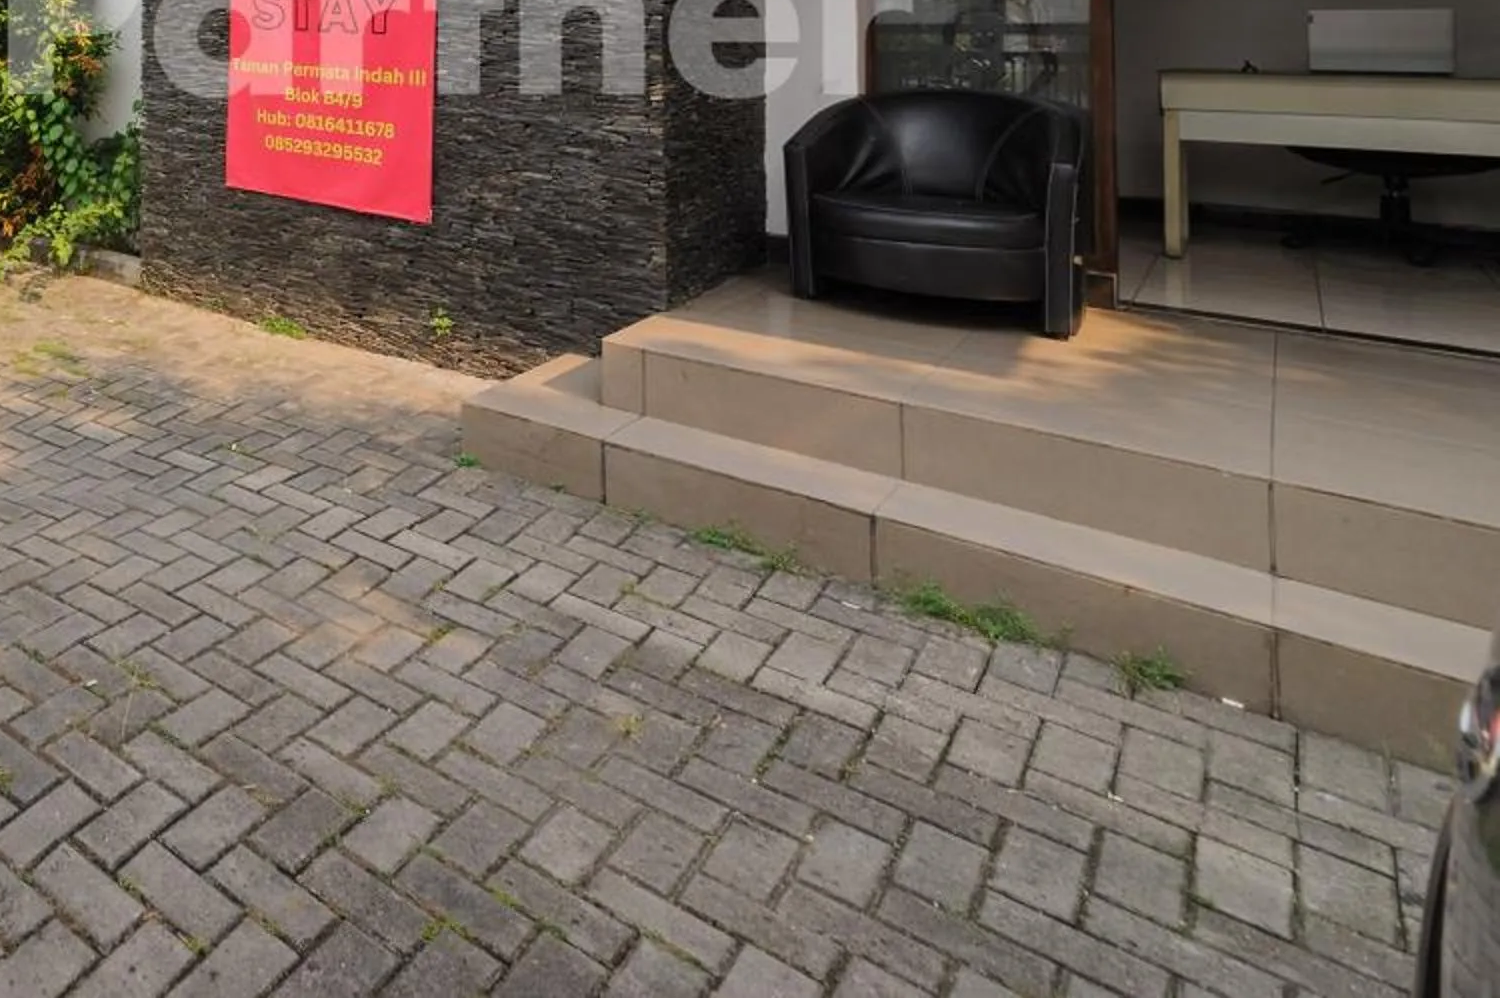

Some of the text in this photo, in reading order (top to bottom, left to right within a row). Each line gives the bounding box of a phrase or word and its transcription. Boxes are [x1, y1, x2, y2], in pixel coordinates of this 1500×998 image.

[231, 57, 279, 76] Taman
[355, 66, 405, 86] Indah
[284, 87, 320, 104] Blok
[256, 108, 395, 139] Hub: 0816411678
